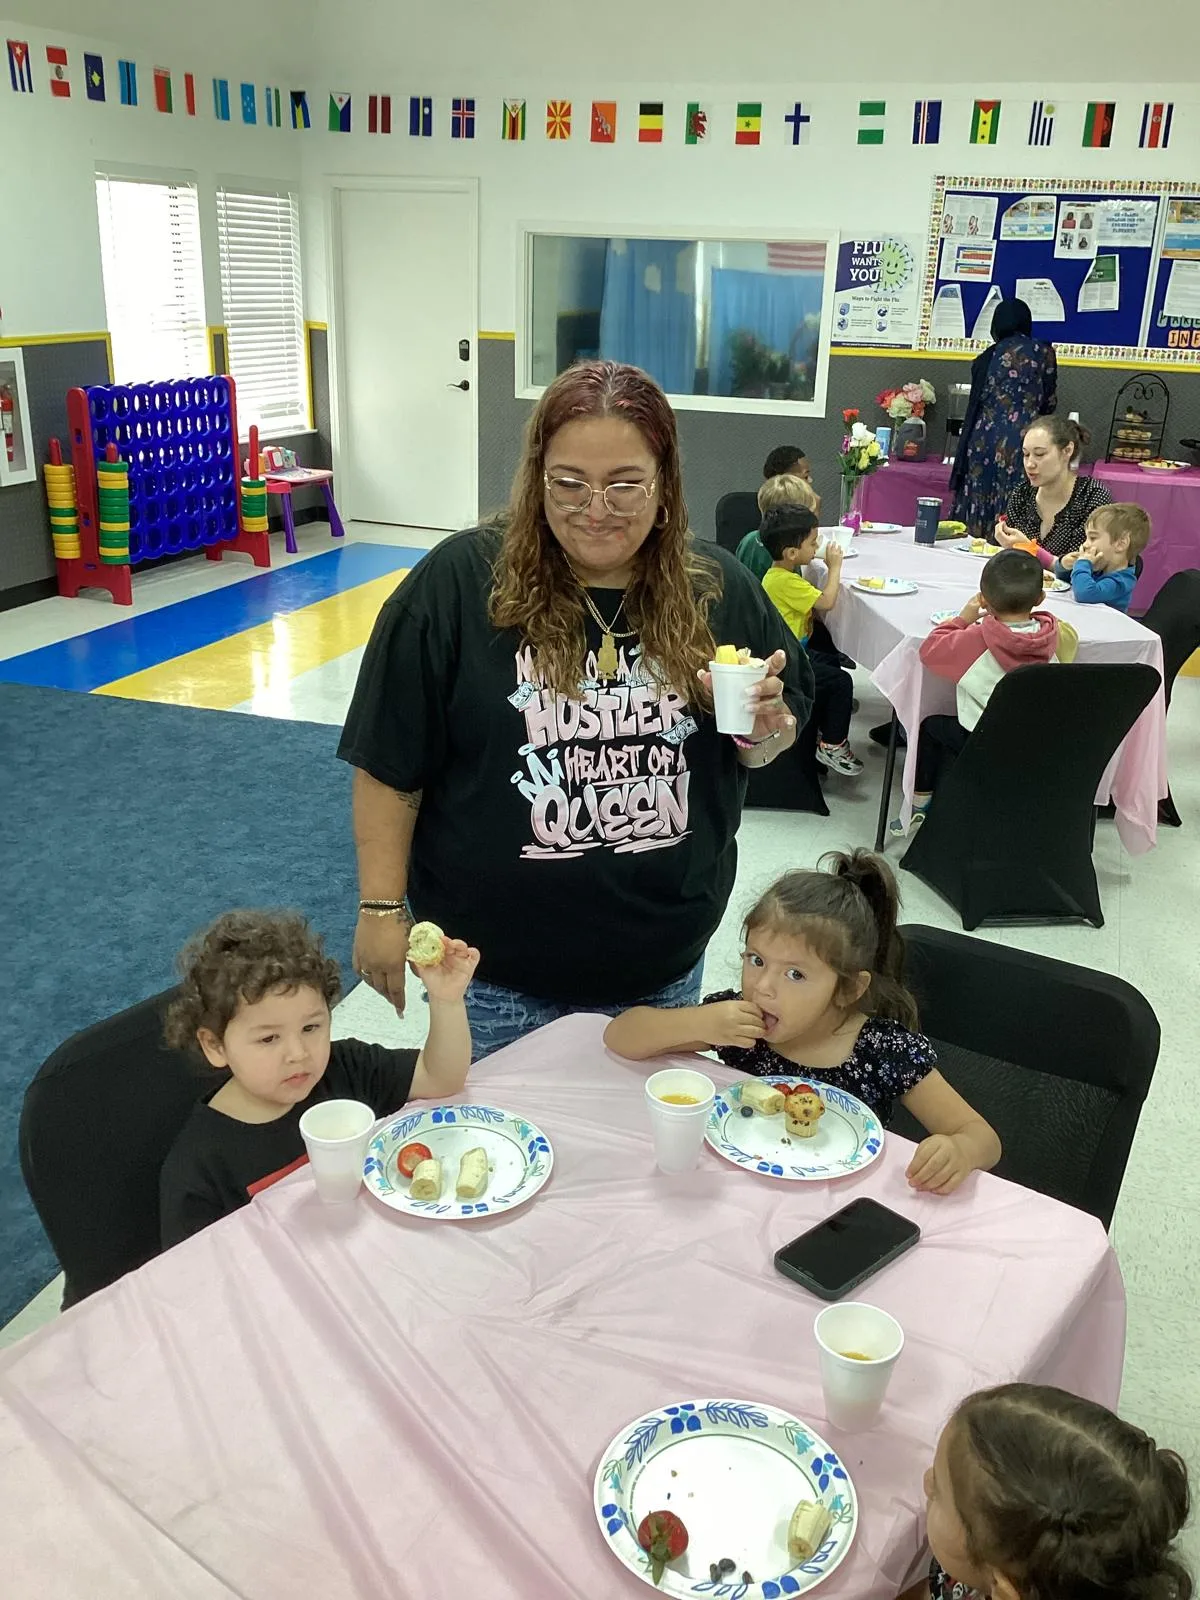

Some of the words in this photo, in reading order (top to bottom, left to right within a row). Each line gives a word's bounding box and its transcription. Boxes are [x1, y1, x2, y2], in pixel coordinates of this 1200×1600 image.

[851, 257, 884, 266] WANTS
[852, 241, 884, 255] FLU
[849, 268, 883, 282] YOU!
[518, 685, 689, 750] HUSTLER
[564, 744, 645, 789] HEART
[647, 744, 675, 776] OF
[676, 742, 687, 774] A
[530, 770, 691, 849] QUEEN
